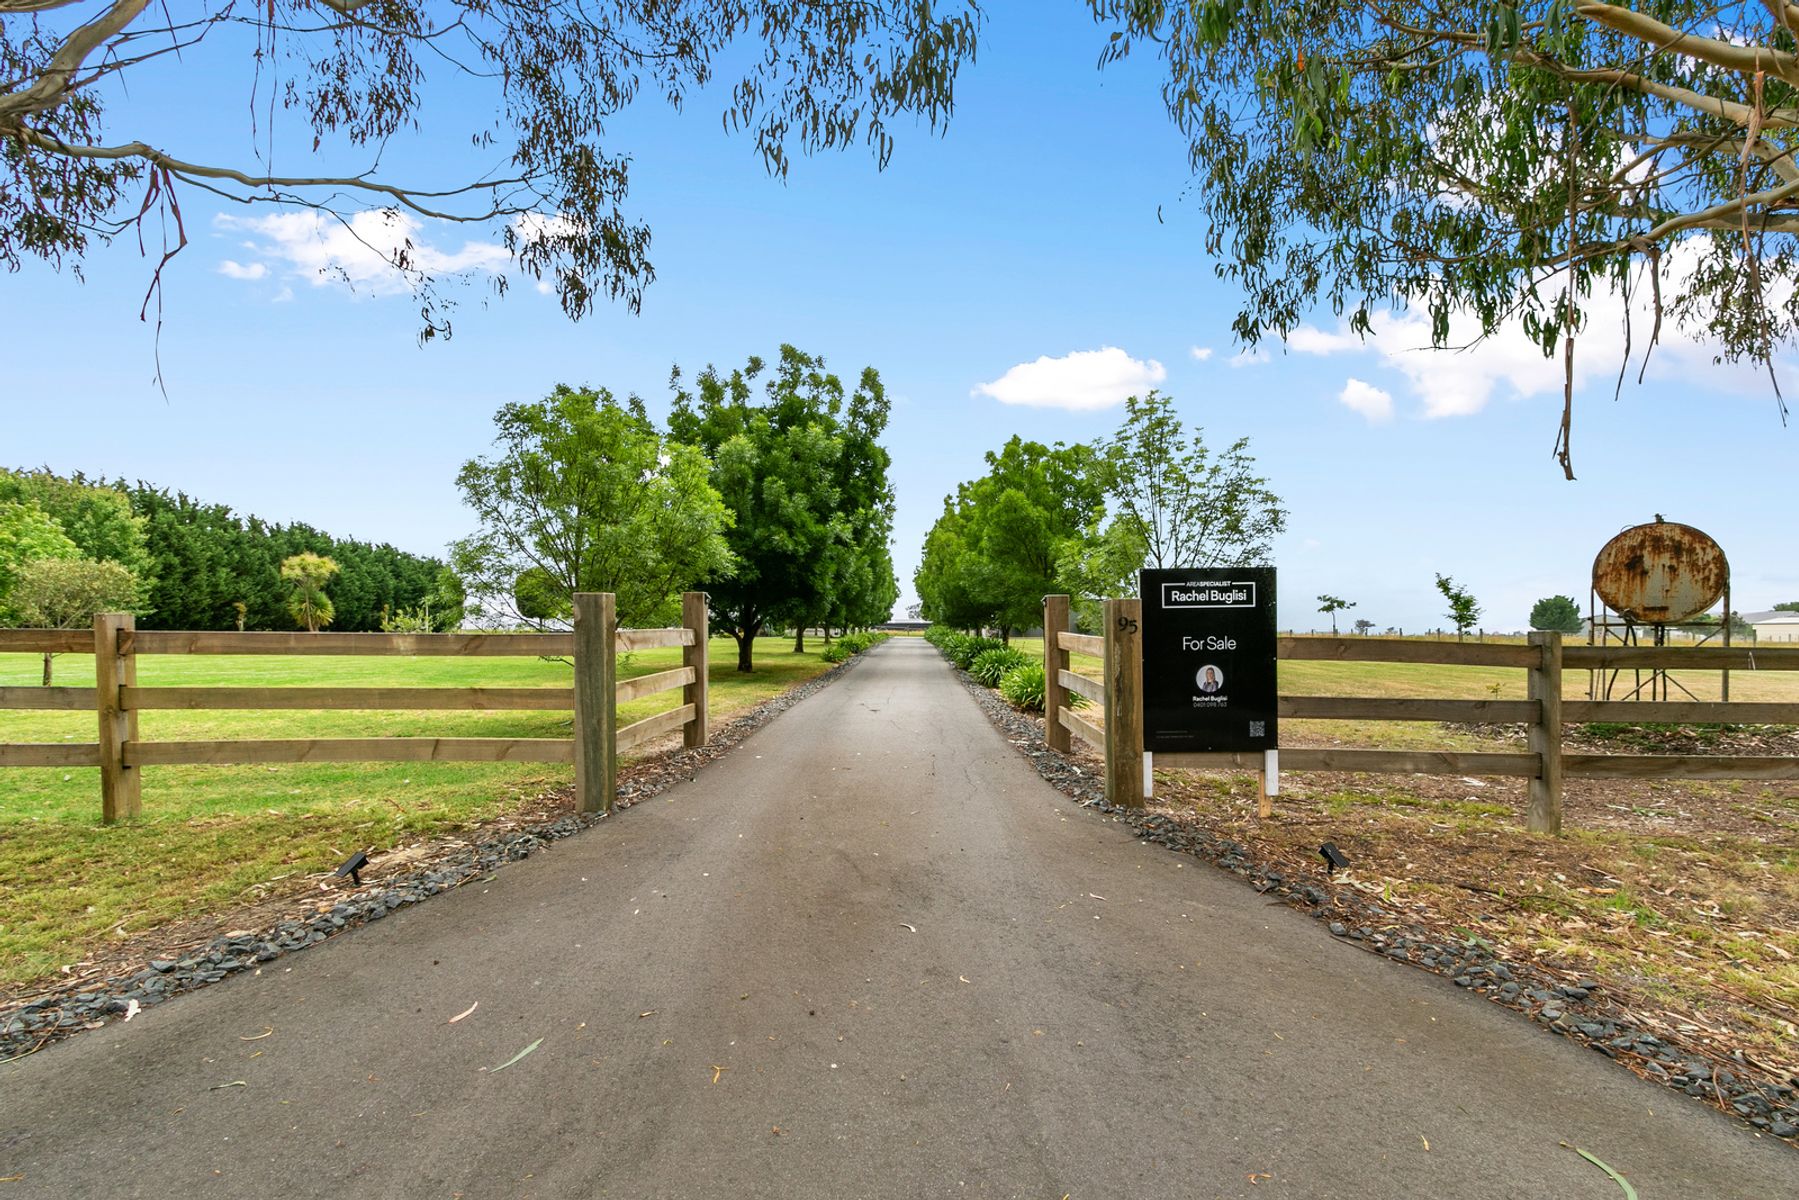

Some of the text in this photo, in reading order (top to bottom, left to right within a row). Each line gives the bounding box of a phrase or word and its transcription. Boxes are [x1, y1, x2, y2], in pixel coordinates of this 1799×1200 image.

[1171, 589, 1247, 604] Rachel Buglisi
[1118, 616, 1138, 635] 95
[1182, 635, 1237, 651] For Sale
[1210, 695, 1228, 703] Buglisi
